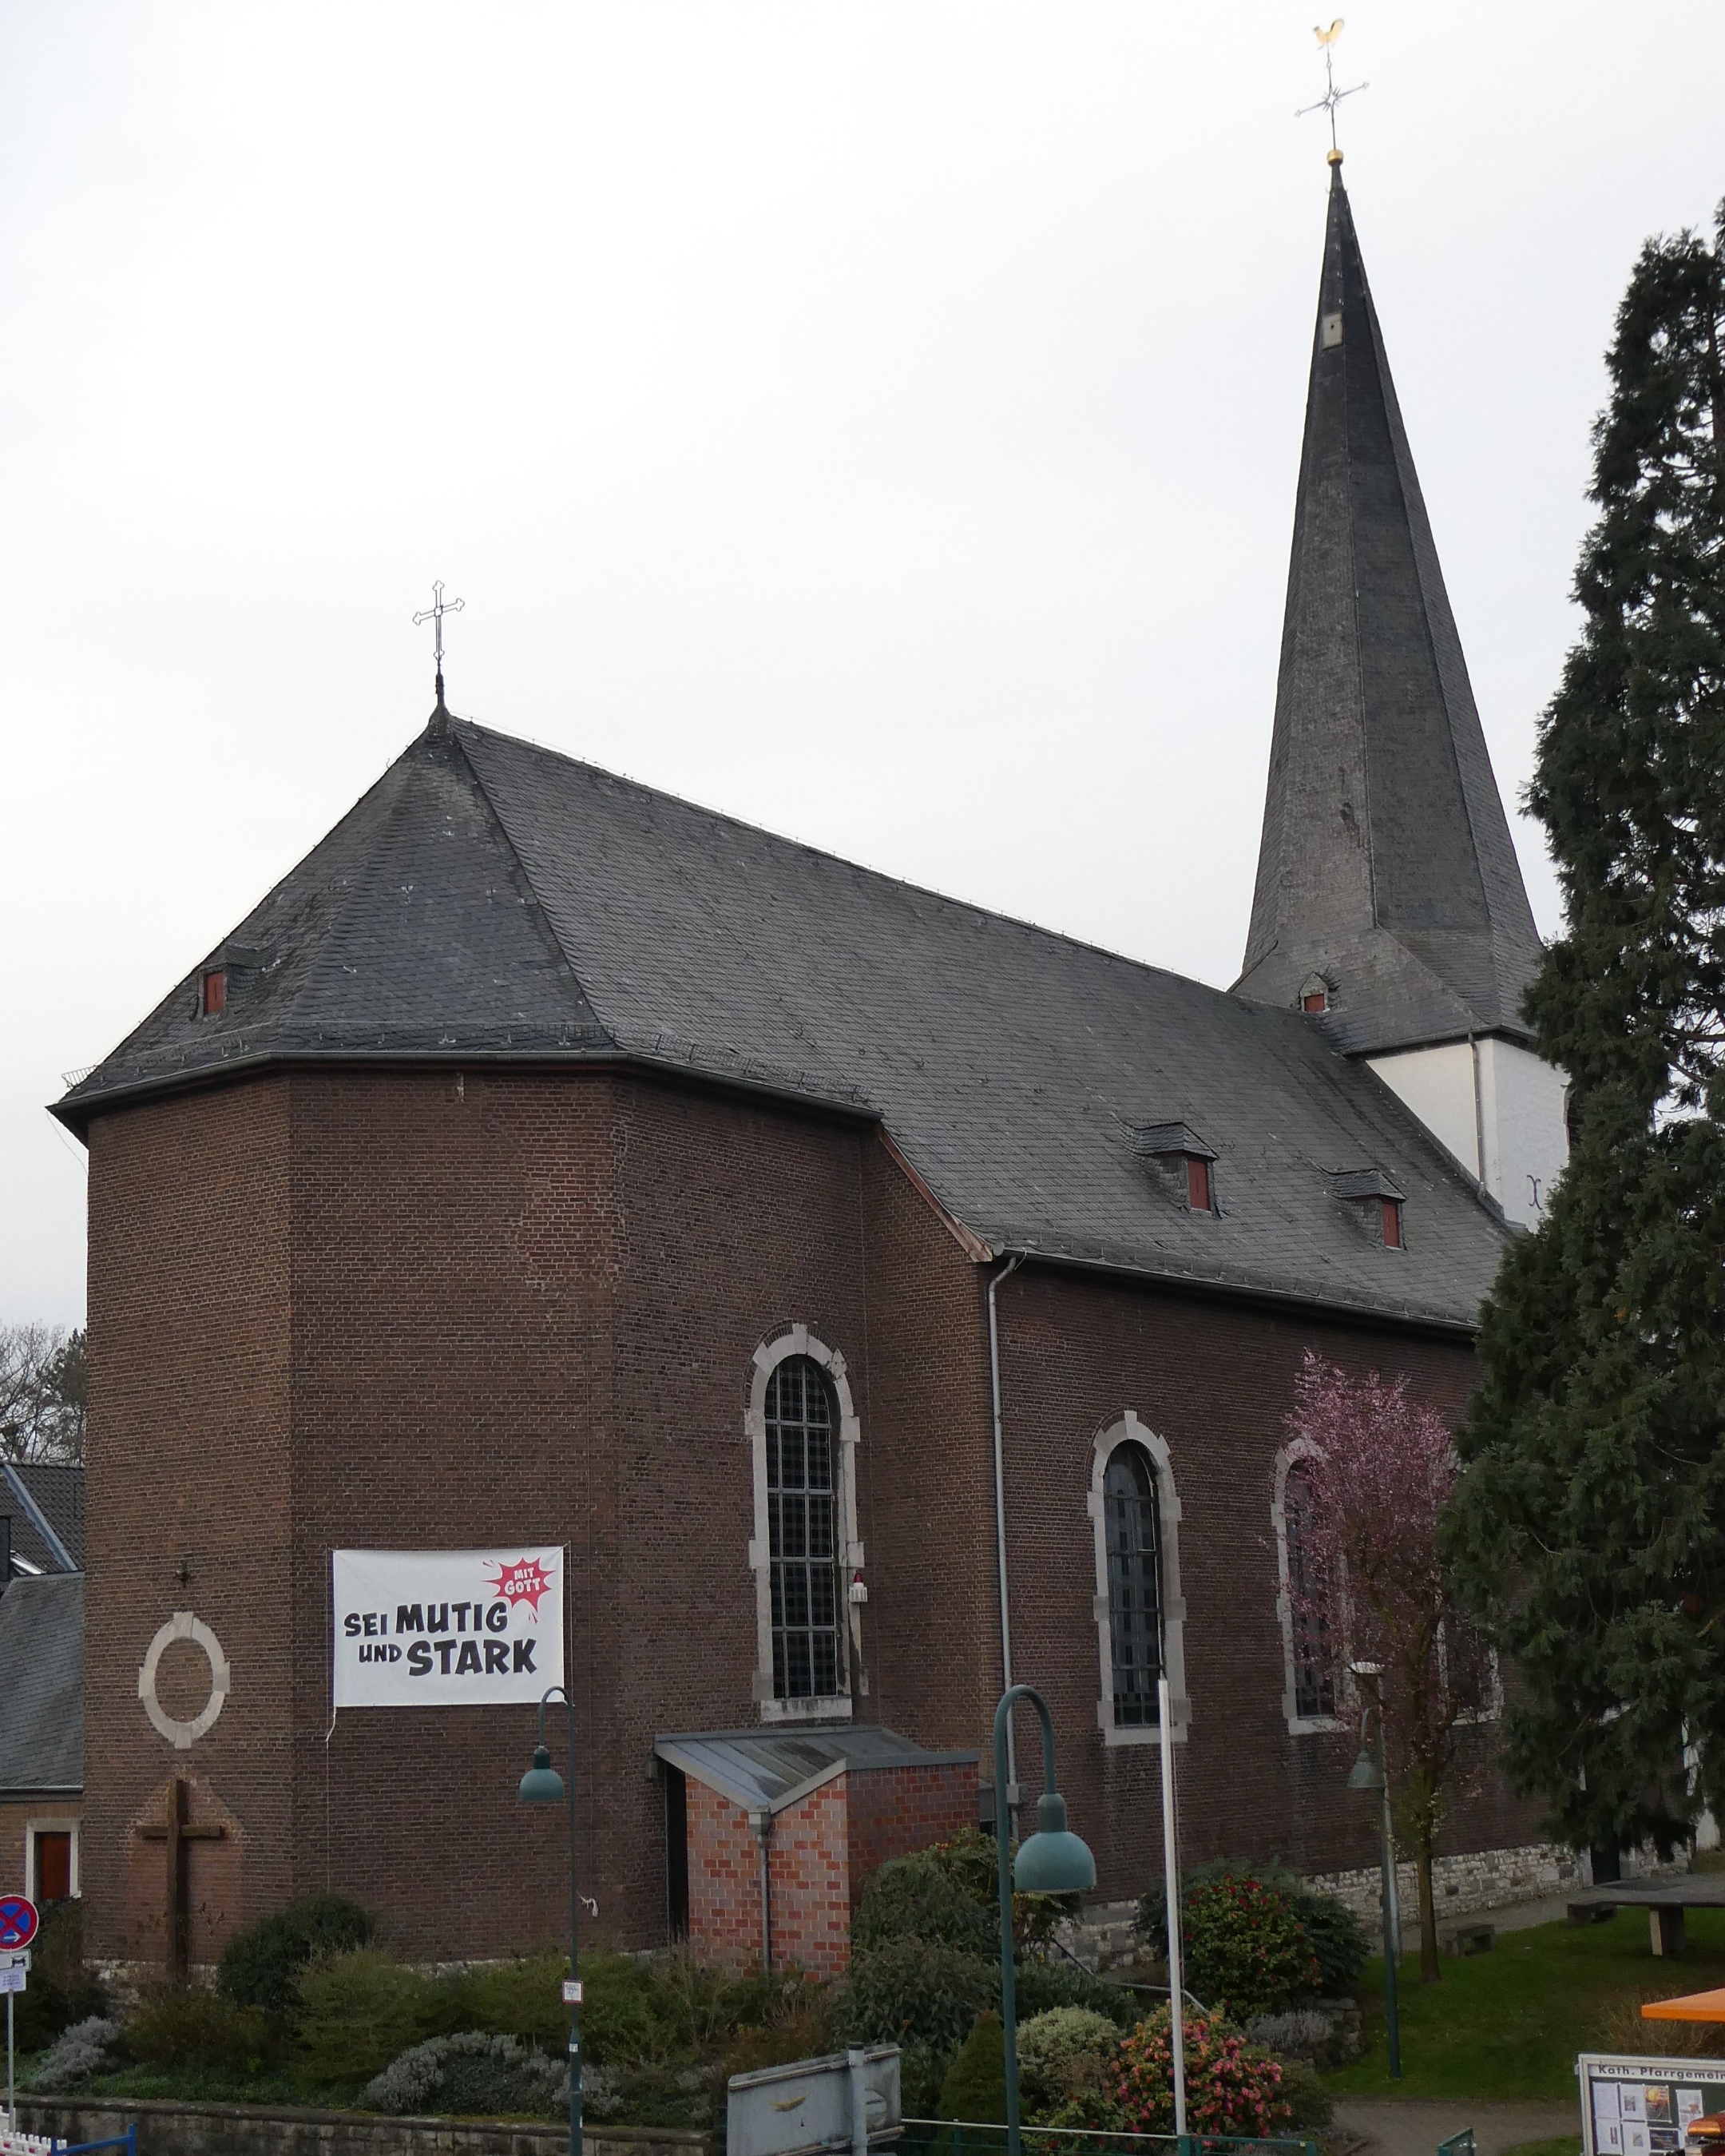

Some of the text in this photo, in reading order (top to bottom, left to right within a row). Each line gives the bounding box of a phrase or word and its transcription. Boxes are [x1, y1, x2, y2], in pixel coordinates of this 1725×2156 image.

[514, 1567, 534, 1580] MIT
[504, 1578, 541, 1595] GOTT
[343, 1602, 508, 1637] SEI MUTIG
[359, 1638, 537, 1677] UND STARK
[1598, 2064, 1635, 2075] Kath.
